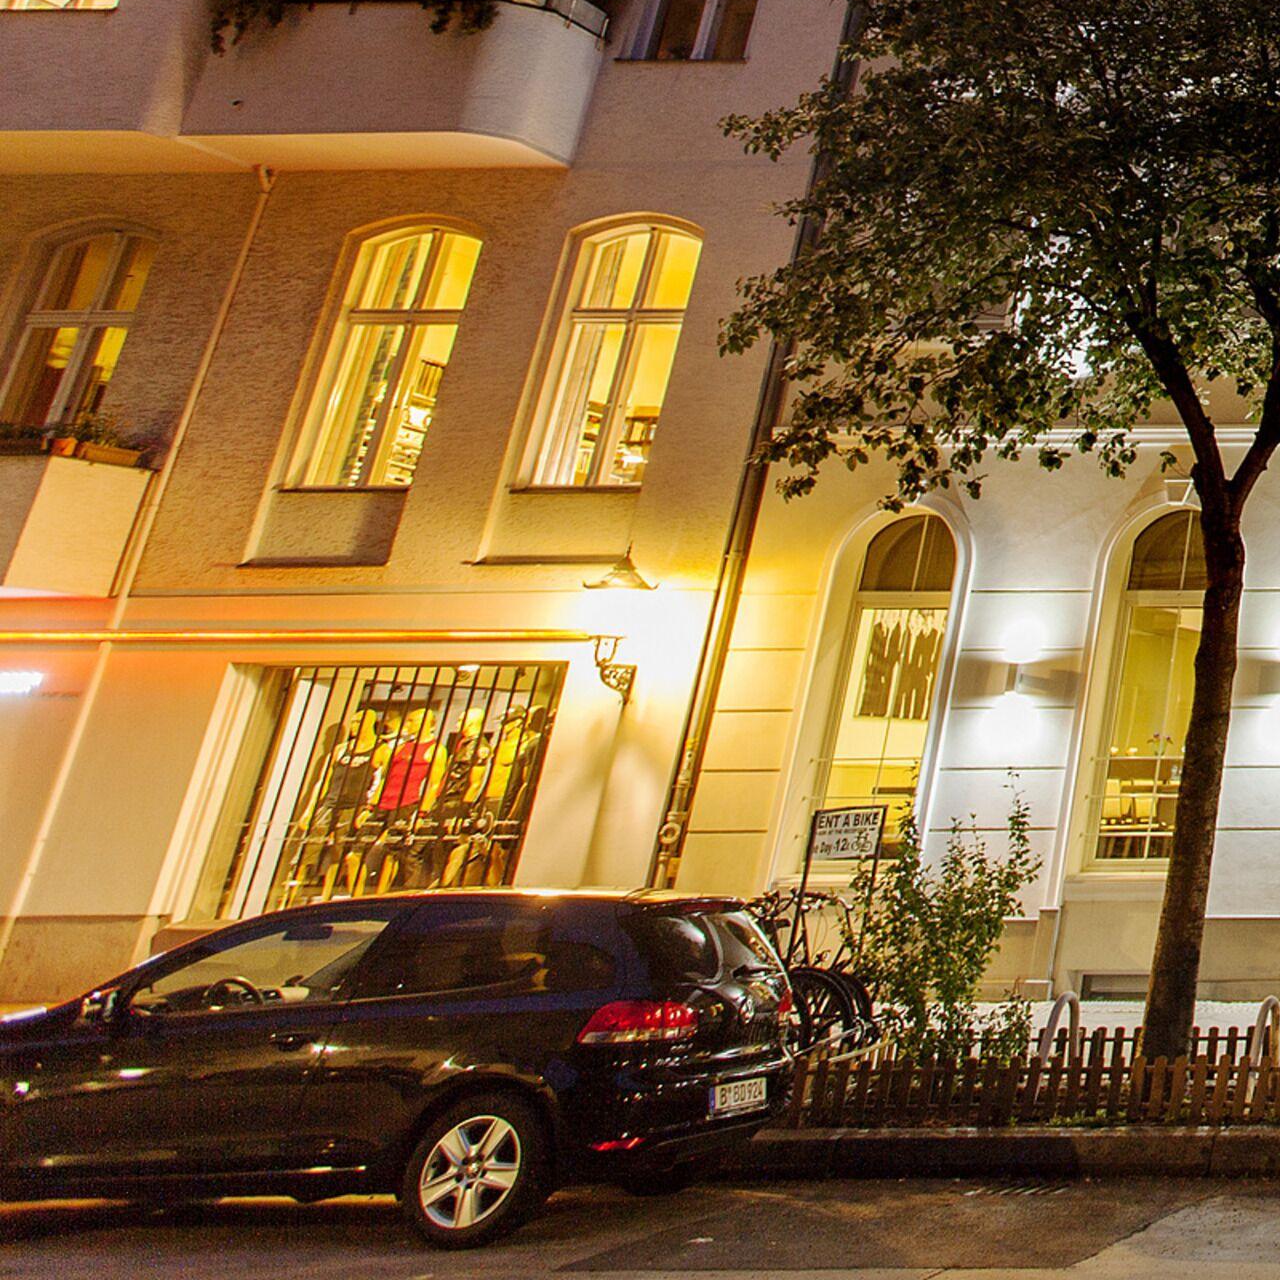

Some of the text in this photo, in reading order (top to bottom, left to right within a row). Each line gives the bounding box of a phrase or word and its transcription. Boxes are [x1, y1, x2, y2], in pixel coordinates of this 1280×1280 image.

[818, 812, 879, 829] ENT A BIKE
